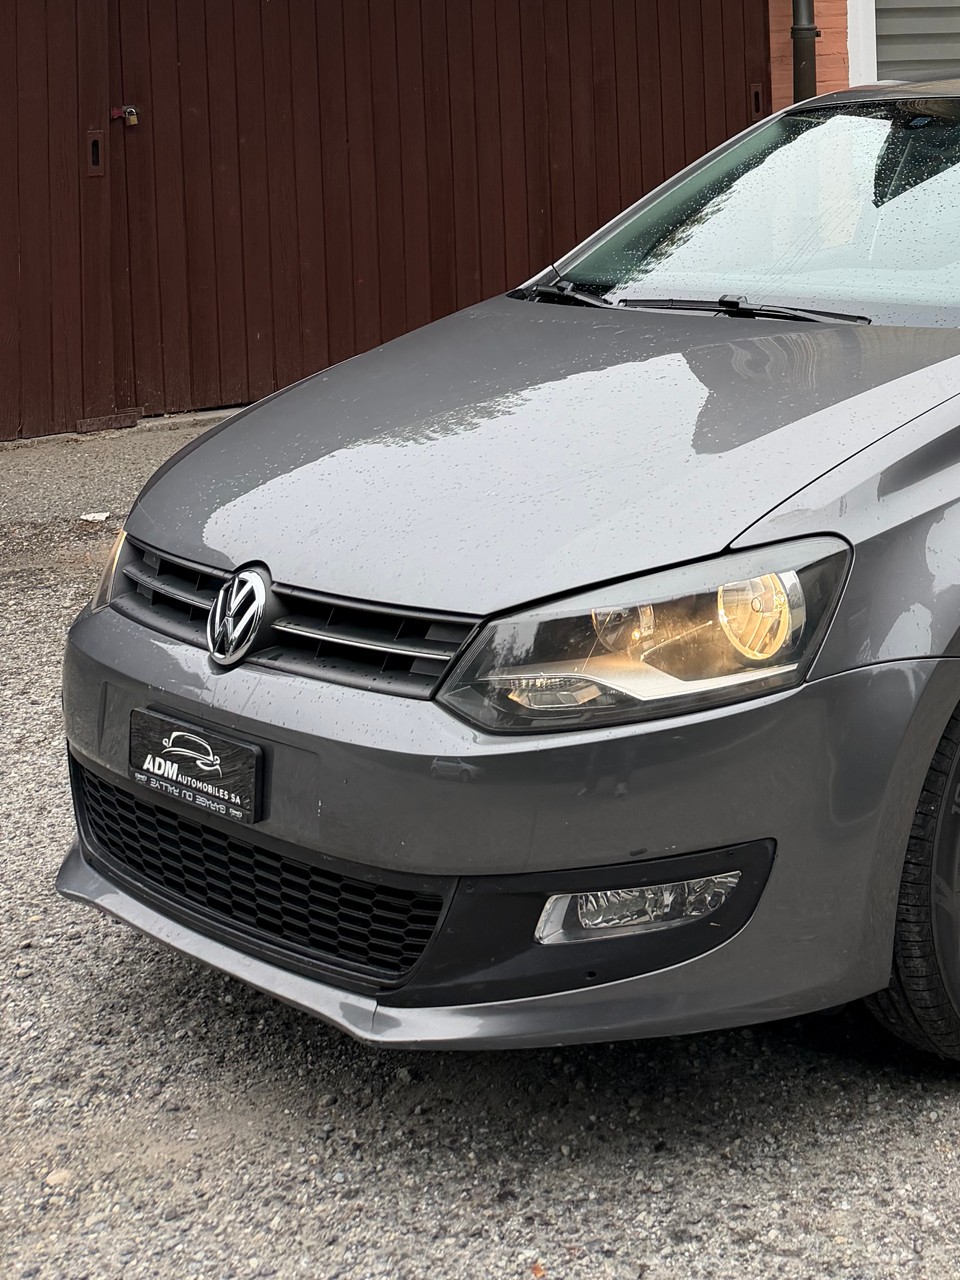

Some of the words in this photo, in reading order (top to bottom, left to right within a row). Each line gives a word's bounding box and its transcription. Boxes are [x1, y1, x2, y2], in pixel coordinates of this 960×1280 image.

[142, 754, 179, 781] ADM
[177, 773, 229, 800] AUTOMOBILES
[230, 793, 241, 805] SA
[150, 778, 180, 796] RALLYE
[181, 790, 193, 801] DU
[195, 794, 226, 814] GARAGE
